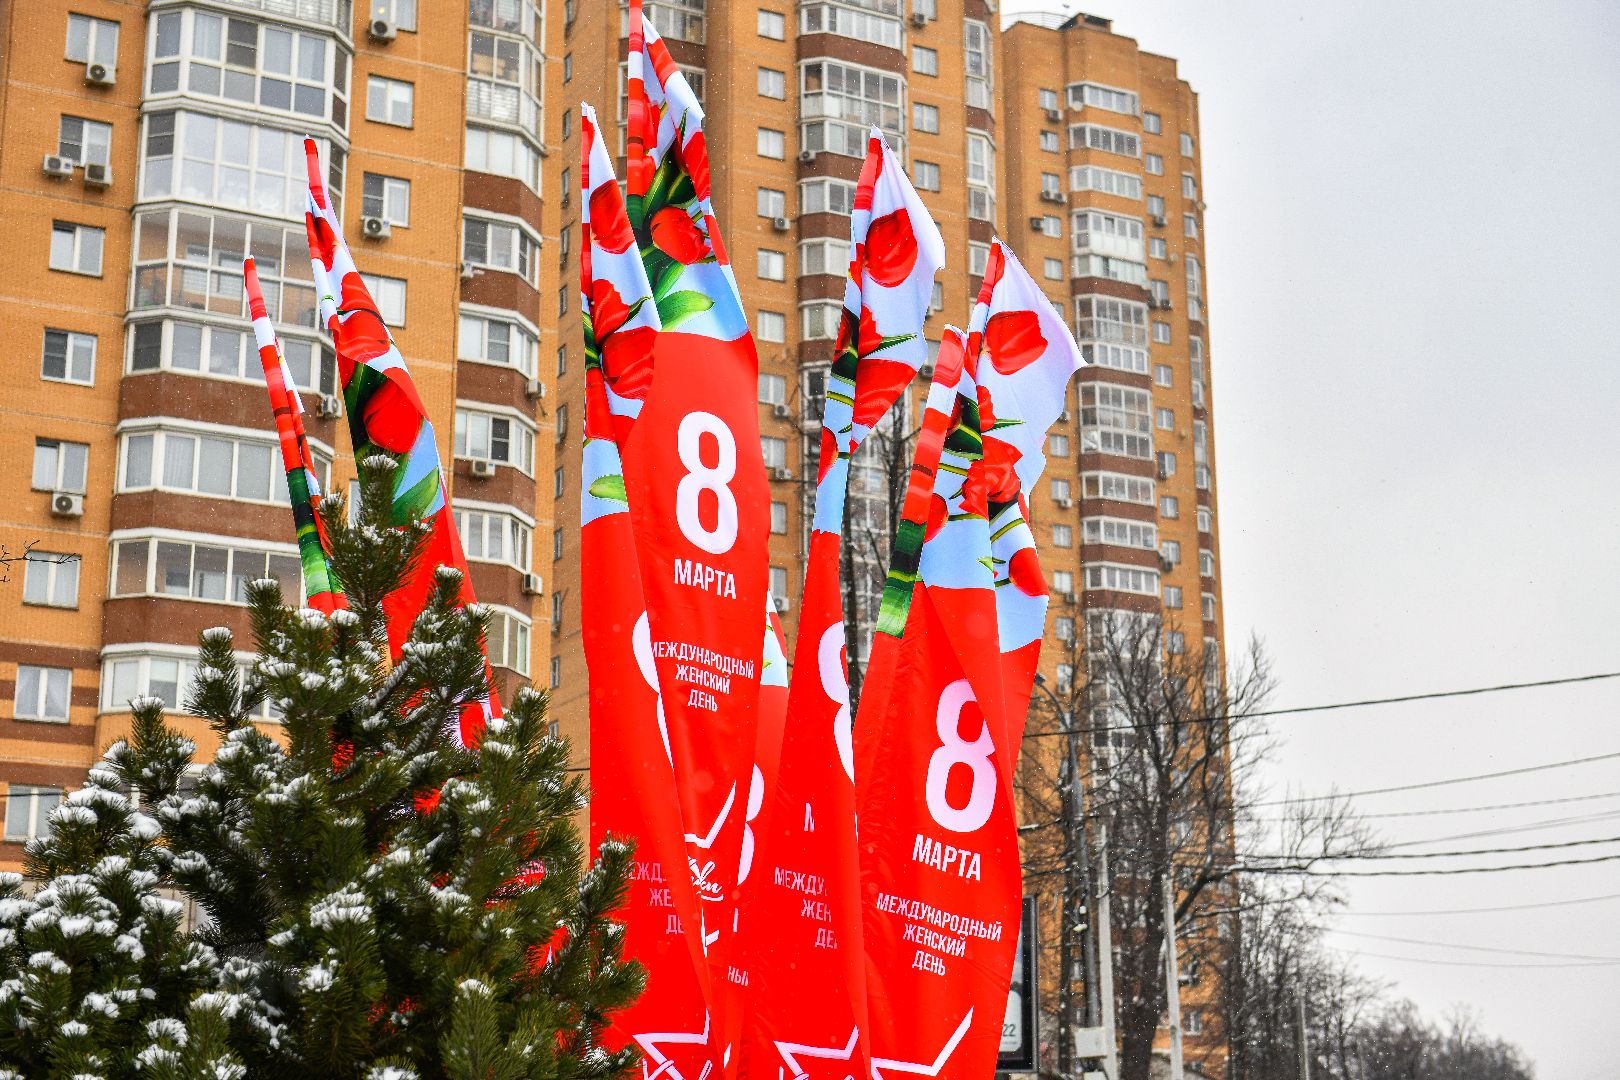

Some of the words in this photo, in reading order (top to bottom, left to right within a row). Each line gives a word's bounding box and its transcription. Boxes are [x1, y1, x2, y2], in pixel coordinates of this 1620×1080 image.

[675, 411, 738, 554] 8
[673, 558, 737, 600] МАРТА
[675, 663, 731, 695] ЖЕНСКИЙ
[687, 688, 718, 712] ДЕНЬ
[925, 678, 997, 833] 8
[912, 833, 981, 882] МАРТА
[876, 892, 1003, 942] МЕЖДУНАРОДНЫЙ
[902, 922, 967, 958] ЖЕНСКИЙ
[911, 950, 946, 976] ДЕНЬ
